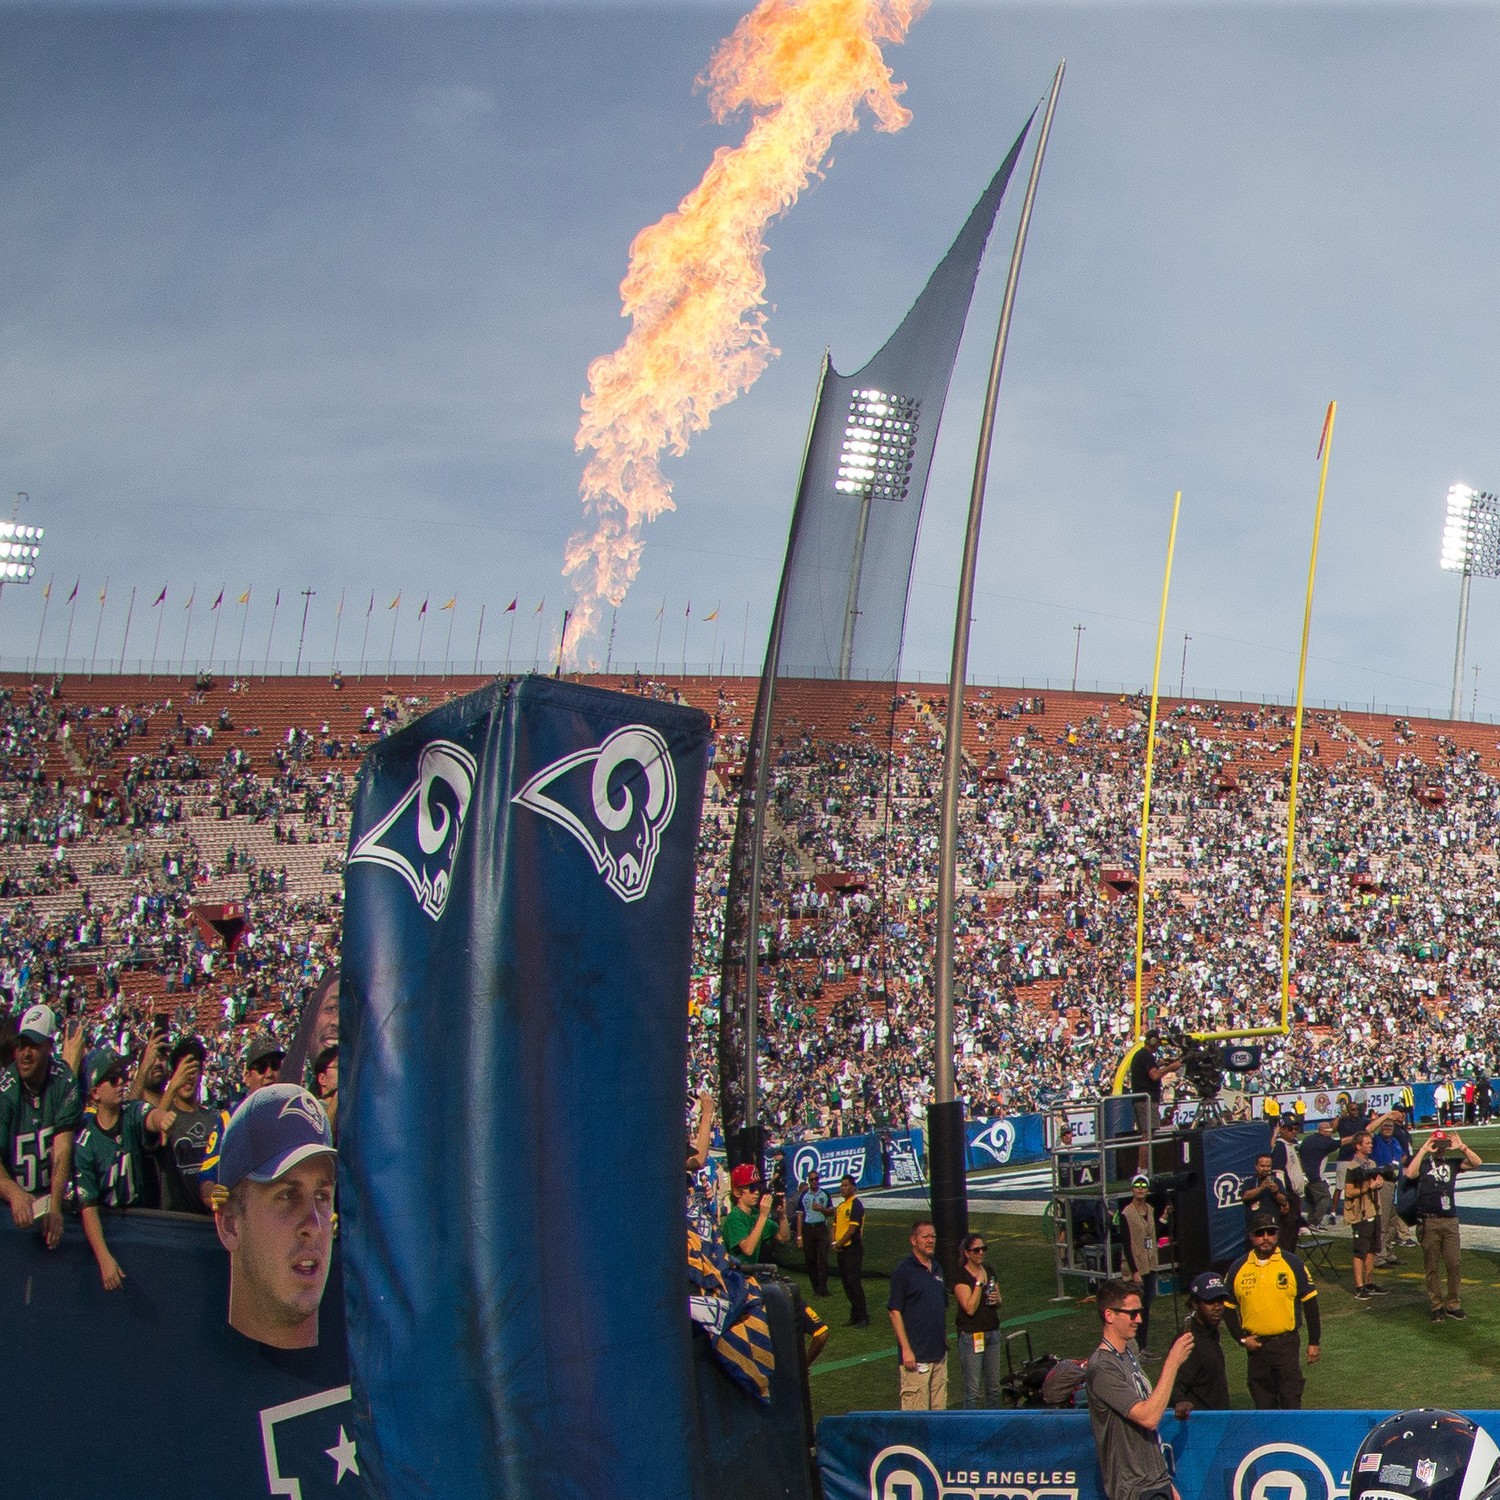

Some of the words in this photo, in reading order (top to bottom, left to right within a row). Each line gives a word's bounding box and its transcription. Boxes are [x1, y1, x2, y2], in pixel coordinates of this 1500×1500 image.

[1383, 1095, 1395, 1106] PT
[1069, 1121, 1087, 1137] EC.
[15, 1126, 54, 1192] 55
[821, 1150, 837, 1160] LOS
[838, 1147, 867, 1157] ANGELES
[794, 1145, 867, 1187] Rams
[1080, 1167, 1093, 1183] A
[947, 1472, 980, 1485] LOS
[985, 1472, 1076, 1485] ANGELES
